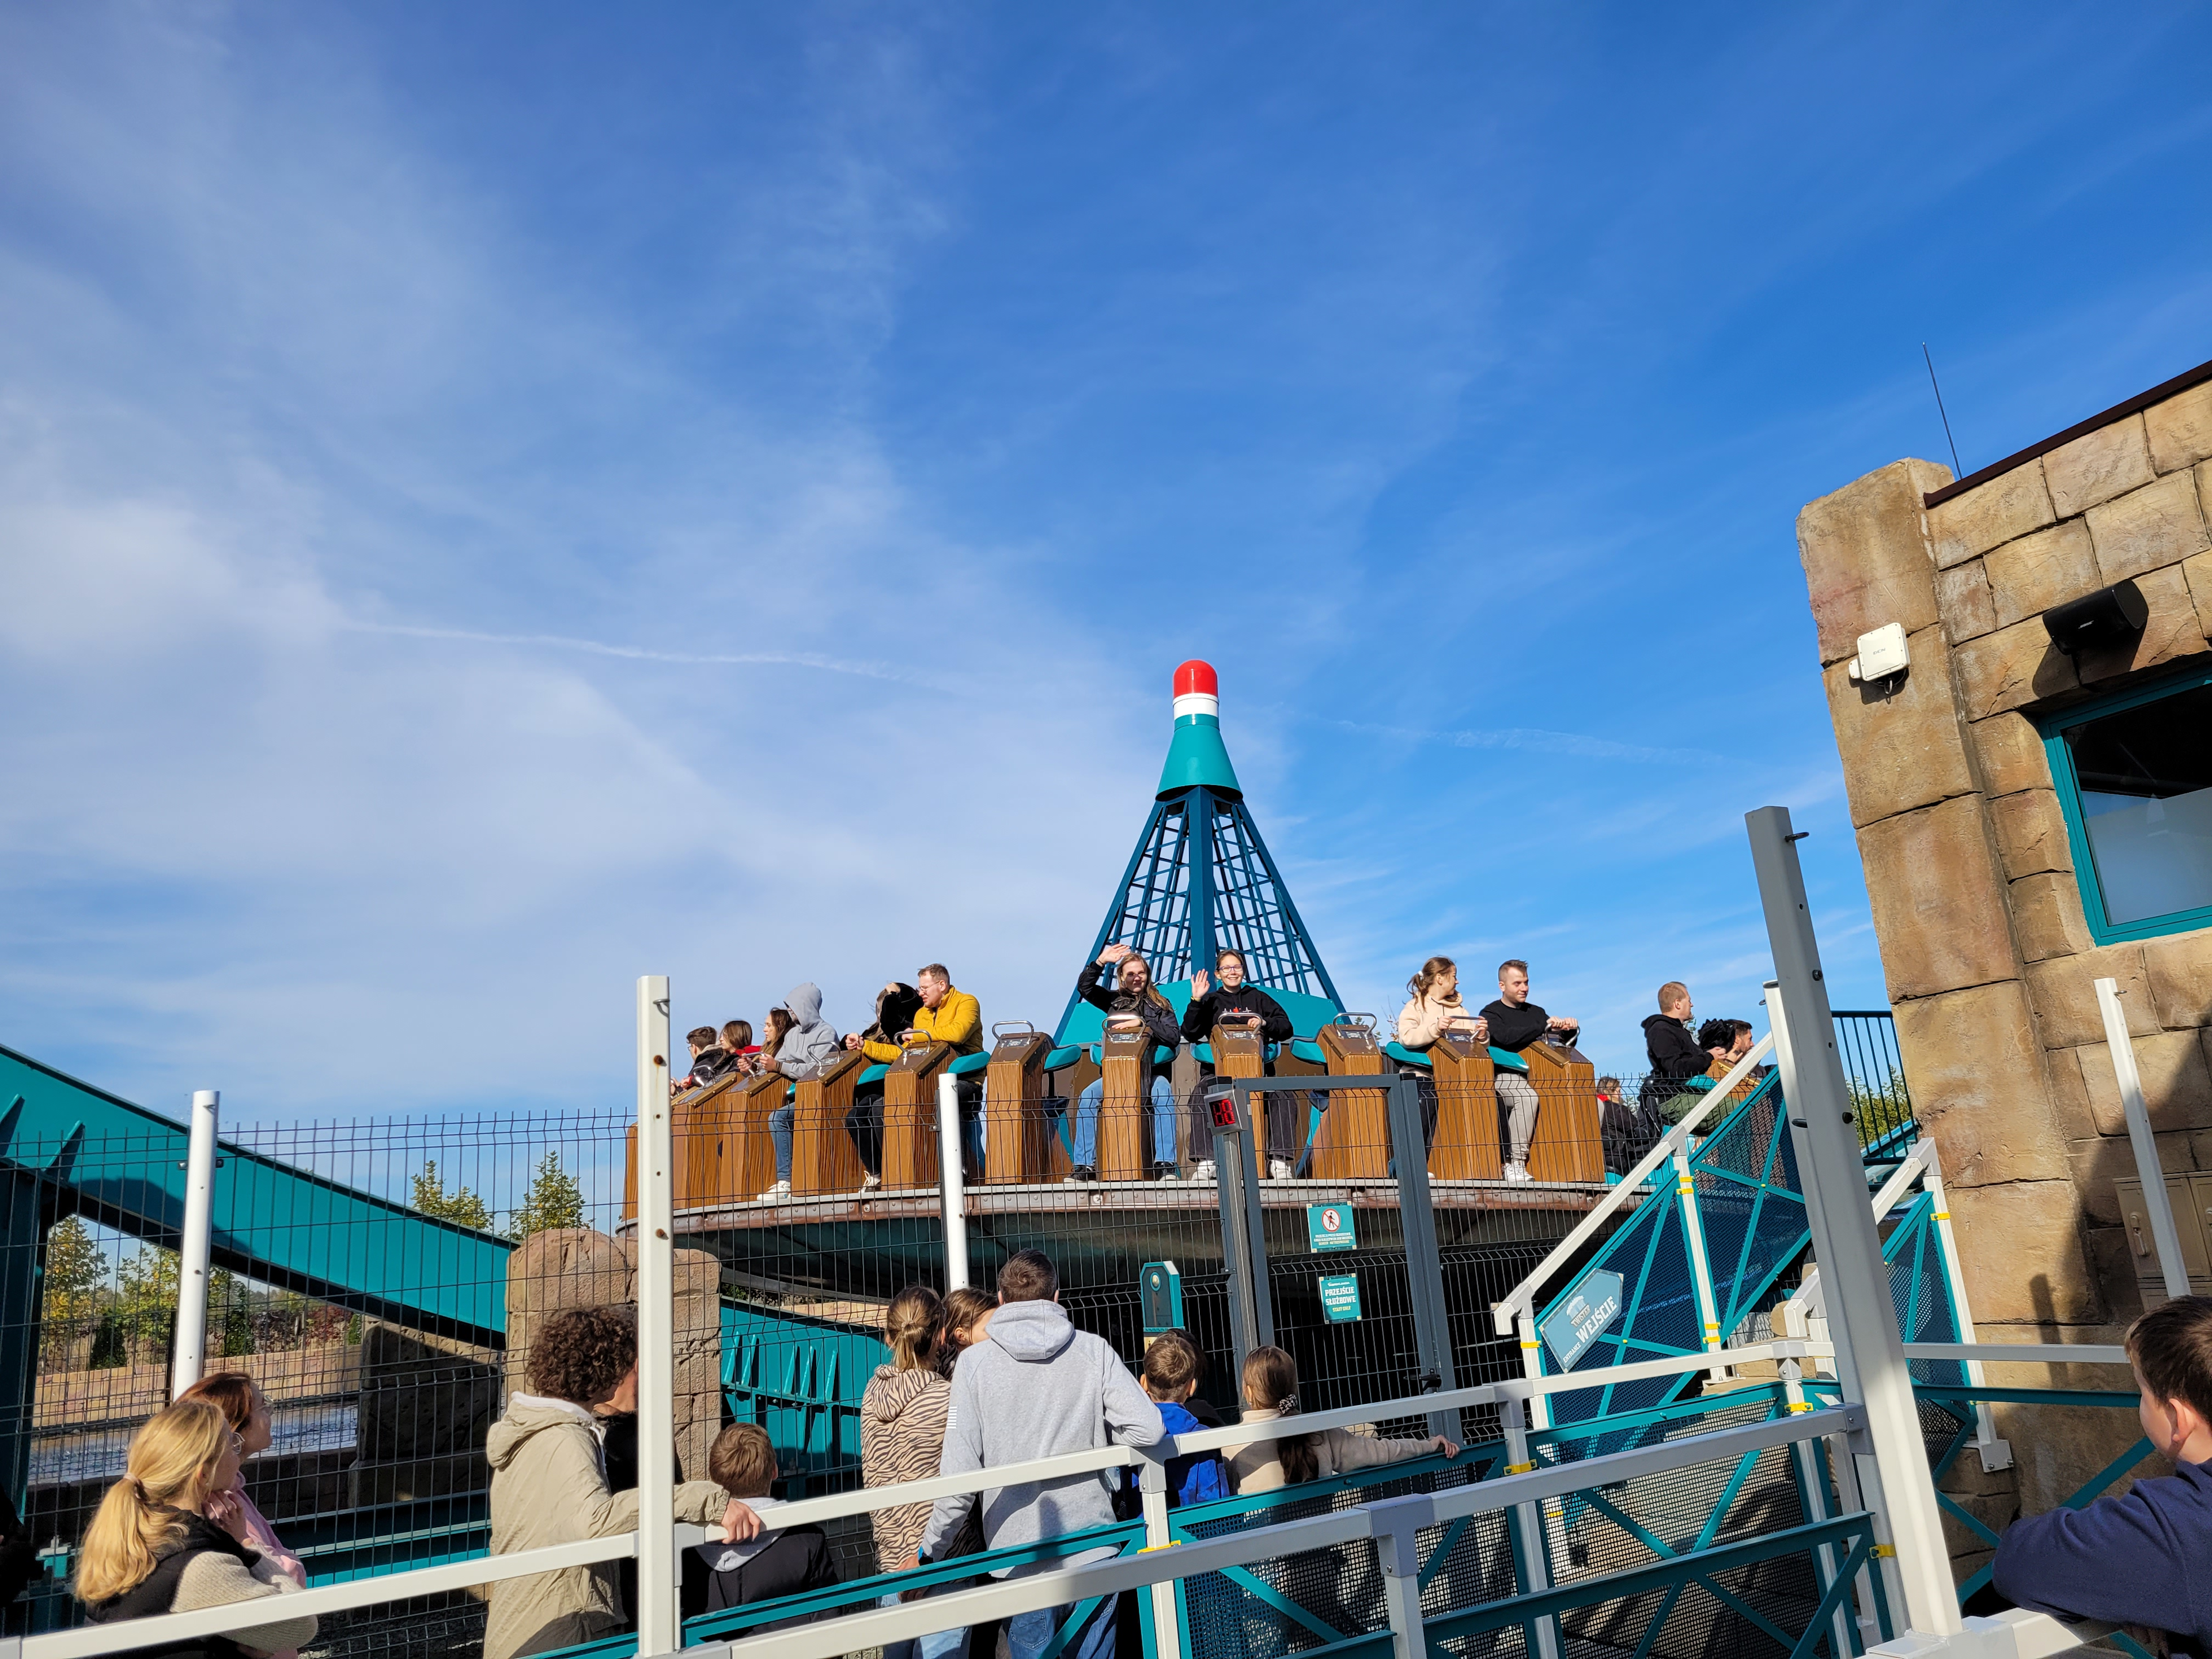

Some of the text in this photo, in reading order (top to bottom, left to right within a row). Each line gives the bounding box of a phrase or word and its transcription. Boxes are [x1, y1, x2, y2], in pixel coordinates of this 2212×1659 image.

[1325, 1286, 1355, 1297] PRZEJŚCIE
[1325, 1296, 1356, 1305] SŁUŻBOWE
[1571, 1304, 1590, 1327] TWISTER
[1563, 1296, 1617, 1363] ENTRANCE WEJŚCIE
